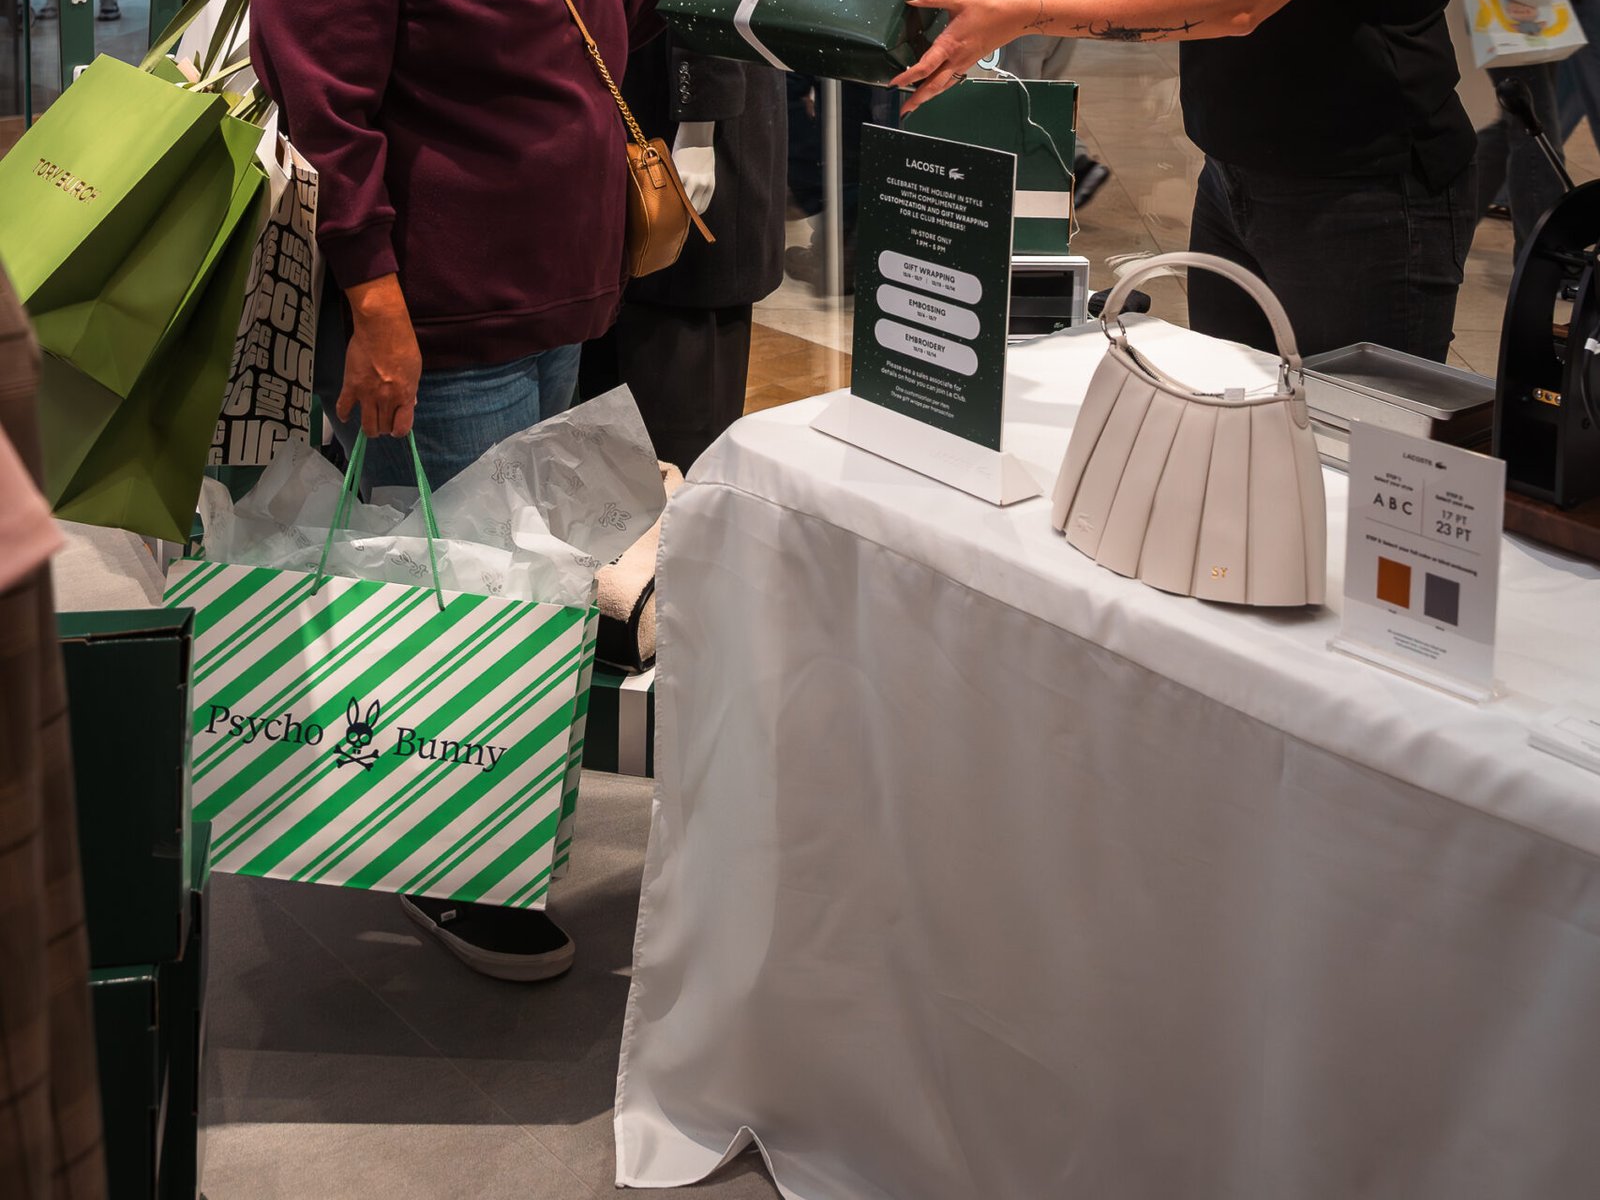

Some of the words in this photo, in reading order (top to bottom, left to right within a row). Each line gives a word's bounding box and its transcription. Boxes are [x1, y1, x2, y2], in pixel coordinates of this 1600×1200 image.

[905, 158, 945, 176] LACOSTE
[886, 177, 918, 190] CELEBRATE
[919, 185, 930, 193] THE
[931, 188, 956, 200] HOLIDAY
[965, 197, 983, 207] STYLE
[901, 190, 916, 199] WITH
[918, 194, 967, 212] COMPLIMENTARY
[880, 194, 926, 211] CUSTOMIZATION
[928, 206, 940, 215] AND
[941, 209, 954, 218] GIFT
[956, 213, 989, 228] WRAPPING
[900, 208, 911, 216] FOR
[920, 214, 935, 223] CLUB
[936, 218, 966, 231] MEMBERS!
[911, 228, 936, 240] IN-STORE
[937, 234, 952, 245] ONLY
[904, 262, 918, 273] GIFT
[919, 266, 955, 284] WRAPPING
[908, 299, 946, 316] EMBOSSING
[905, 334, 946, 353] EMBROIDERY
[1402, 453, 1432, 466] LACOSTE
[1373, 492, 1384, 507] A
[1389, 497, 1397, 510] B
[1402, 501, 1413, 516] C
[1442, 510, 1453, 520] 17
[1456, 514, 1467, 525] PT
[1436, 520, 1451, 536] 23
[1456, 527, 1472, 542] PT
[1212, 566, 1228, 579] SY
[205, 704, 324, 747] Psycho
[392, 727, 508, 773] Bunny
